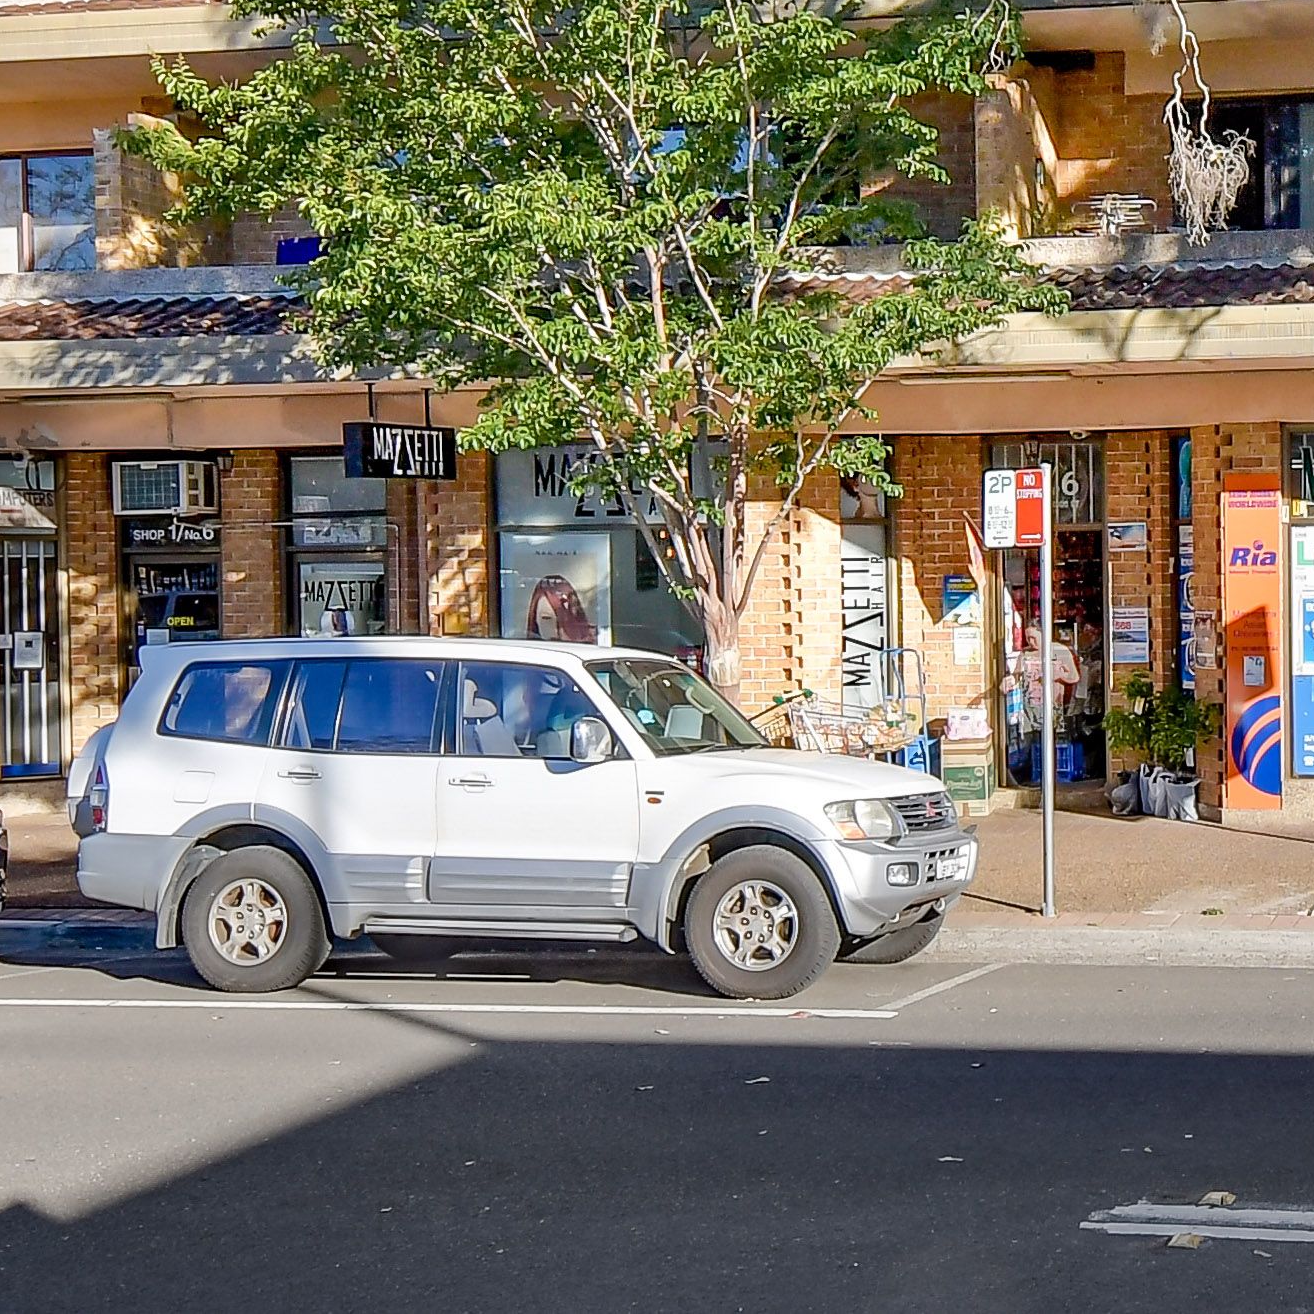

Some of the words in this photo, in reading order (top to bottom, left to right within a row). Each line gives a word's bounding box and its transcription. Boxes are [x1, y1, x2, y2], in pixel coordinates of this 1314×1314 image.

[989, 477, 1012, 494] 2P
[1022, 474, 1036, 486] NO
[133, 529, 165, 540] SHOP
[1229, 539, 1277, 566] Ria
[870, 556, 884, 609] HAIR
[167, 617, 194, 626] OPEN
[841, 557, 884, 686] MAZZETTI
